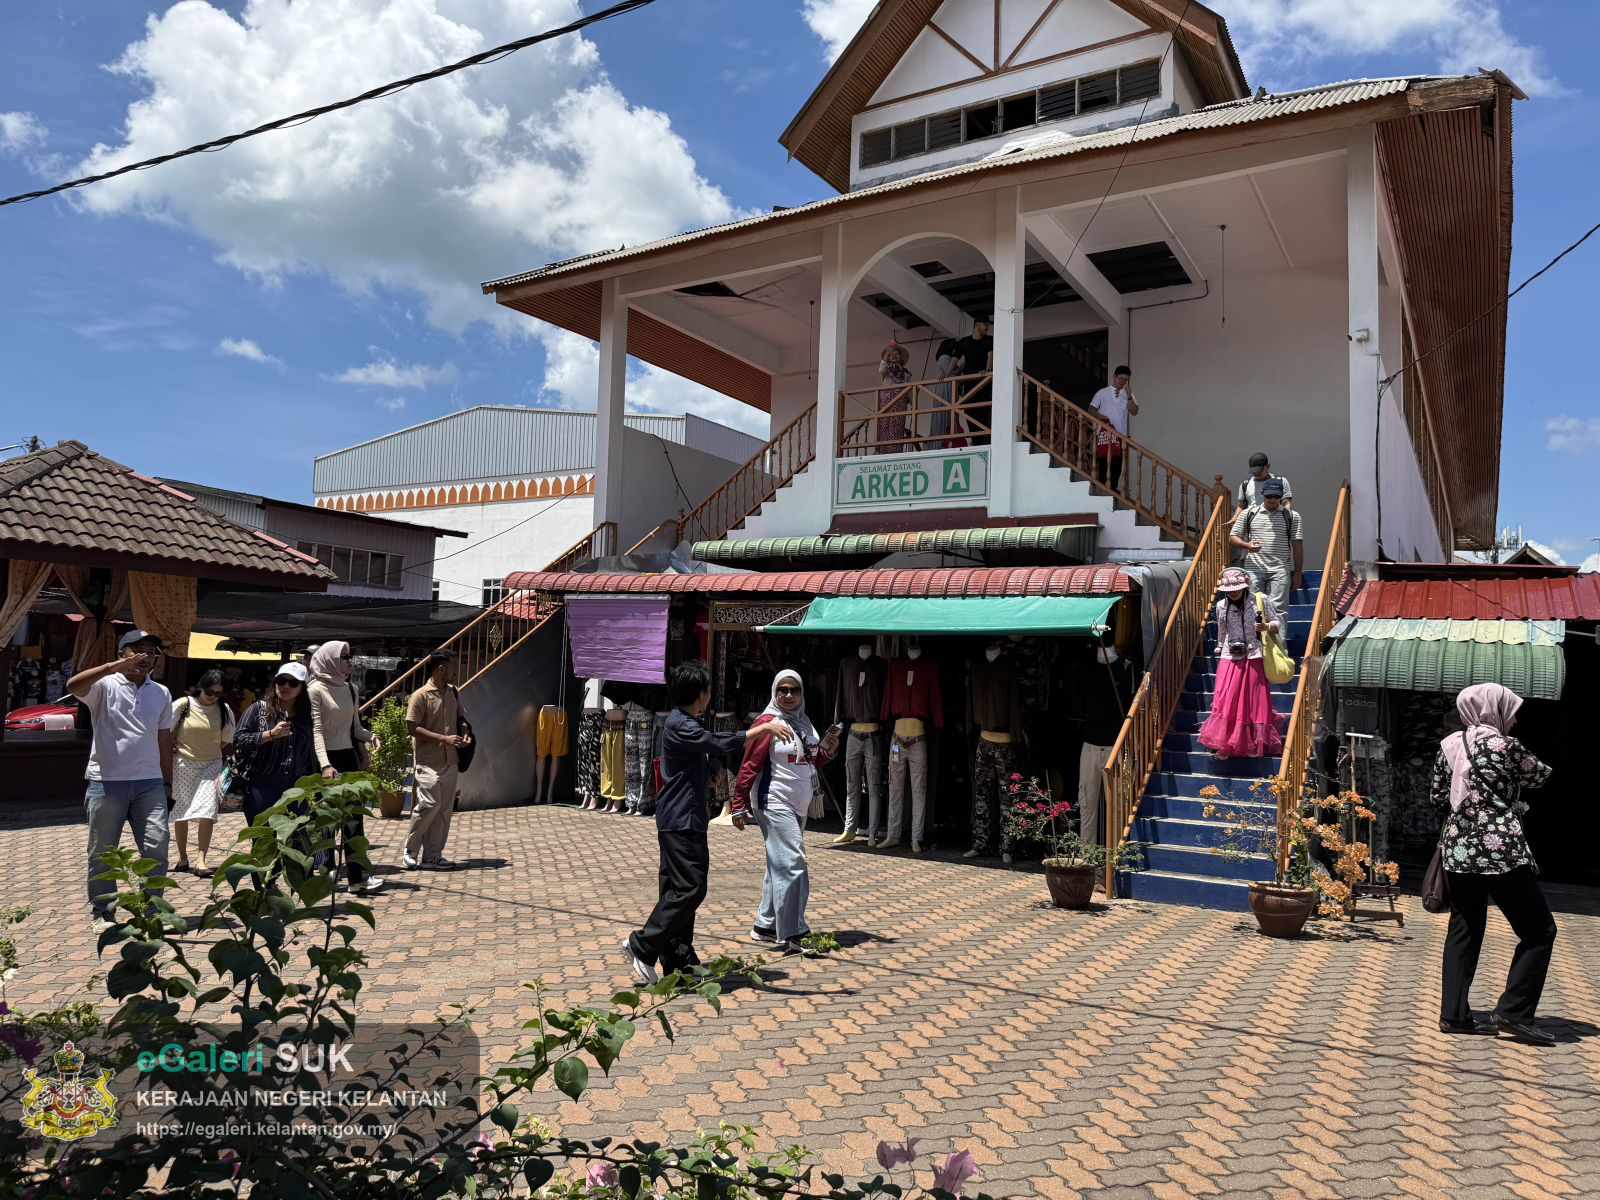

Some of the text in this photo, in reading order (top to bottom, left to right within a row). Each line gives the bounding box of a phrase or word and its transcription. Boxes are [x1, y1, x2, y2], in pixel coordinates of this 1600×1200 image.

[859, 462, 922, 474] SELAMAT DATANG
[851, 462, 968, 500] ARKED A
[1345, 699, 1377, 708] adidas
